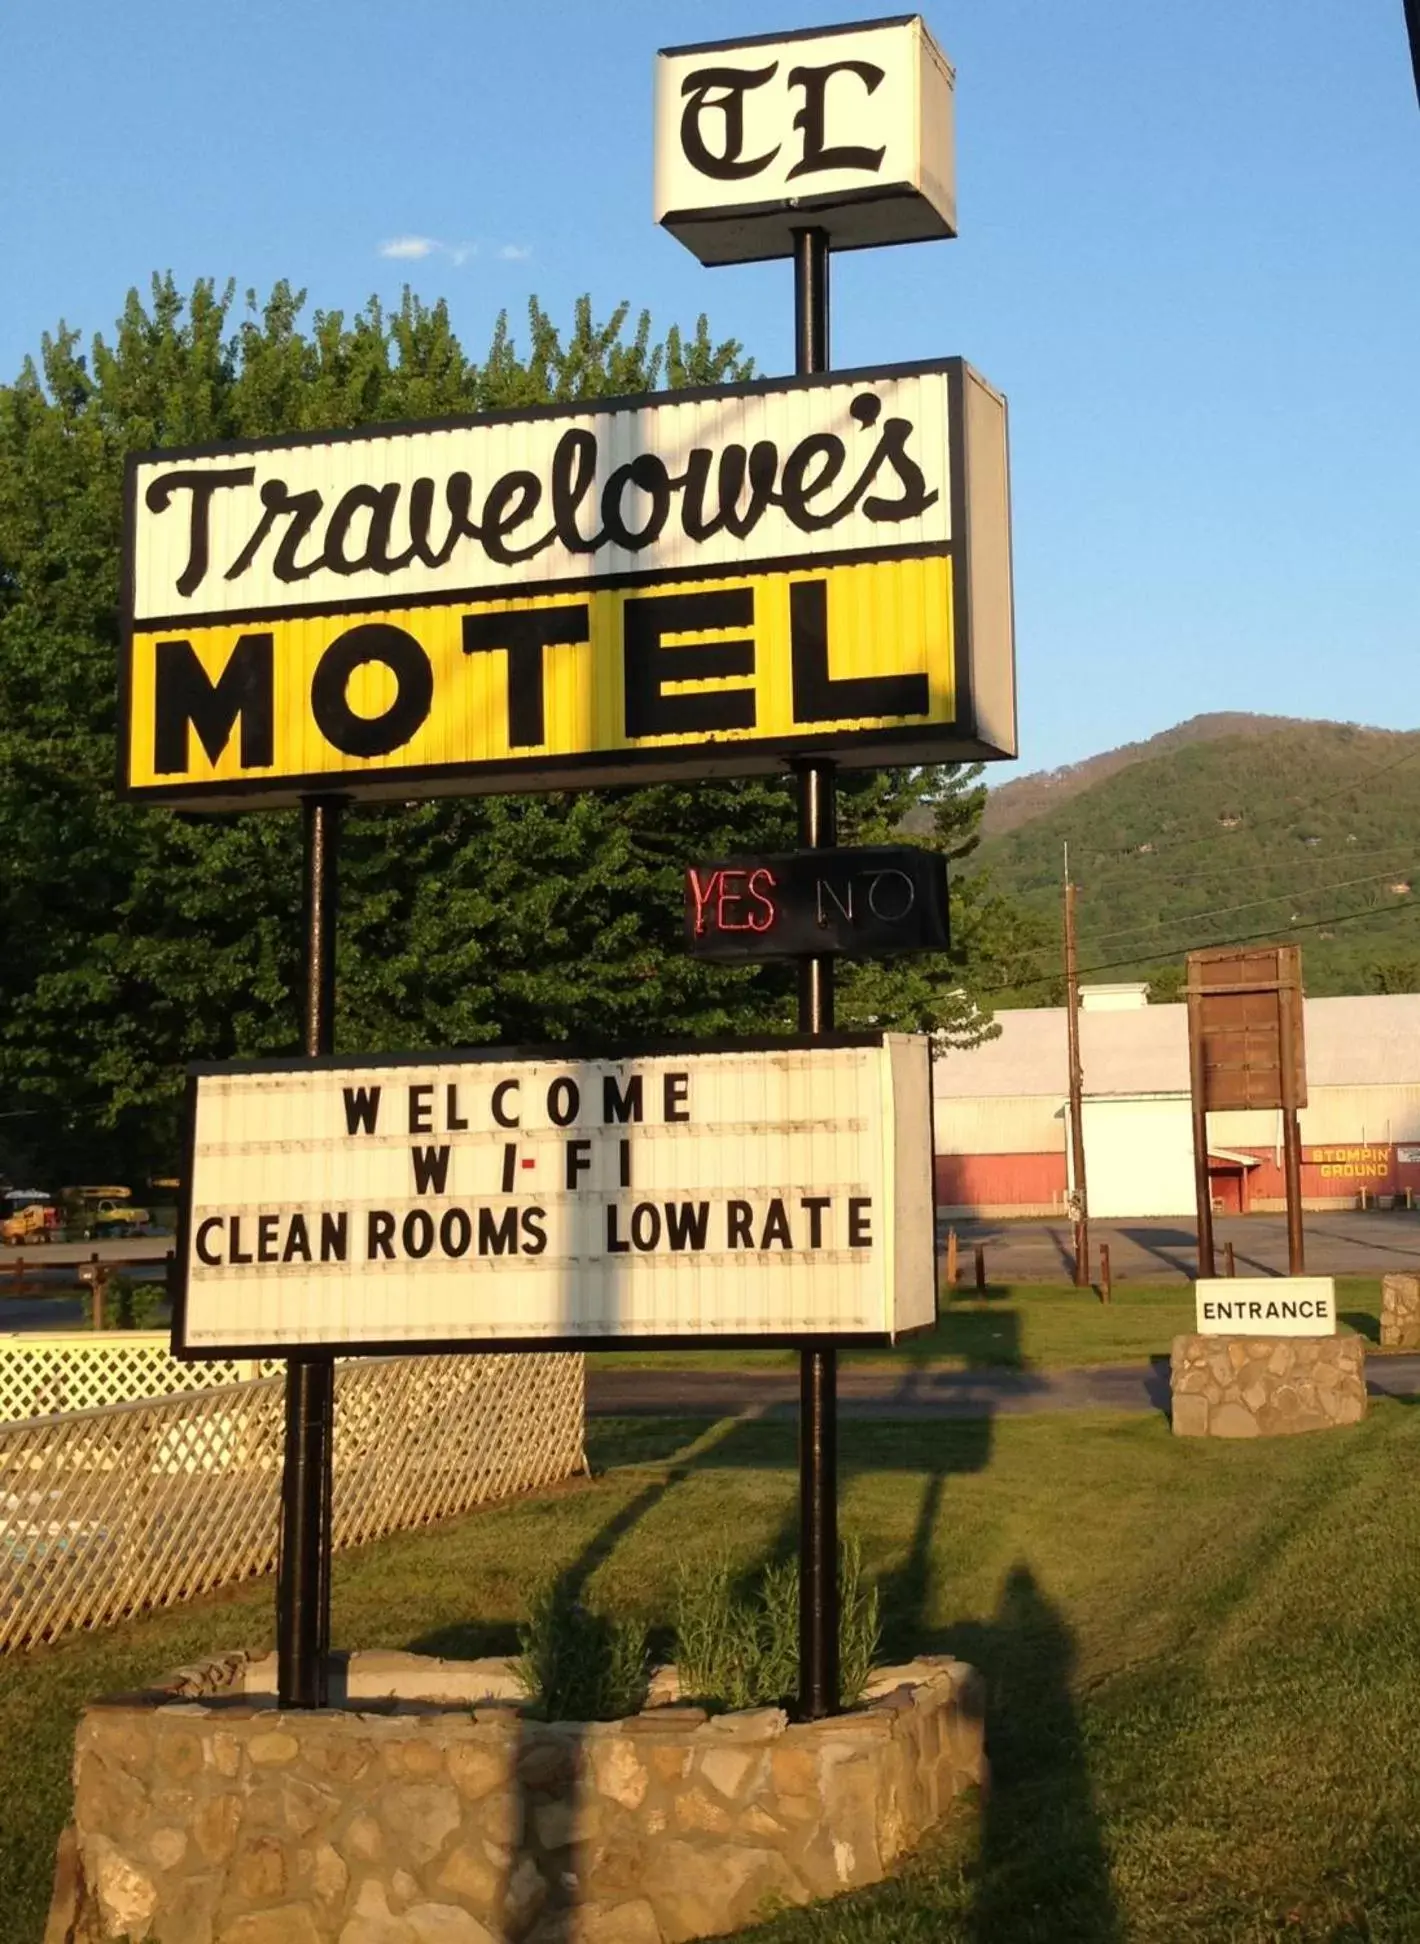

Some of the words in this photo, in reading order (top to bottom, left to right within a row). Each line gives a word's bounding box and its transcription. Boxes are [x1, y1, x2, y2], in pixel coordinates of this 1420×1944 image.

[680, 60, 886, 183] TL
[145, 392, 939, 597] Travelowe's
[154, 580, 930, 774] MOTEL
[689, 868, 776, 933] YES
[815, 868, 914, 924] NO
[342, 1072, 690, 1135] WELCOME
[1320, 1163, 1388, 1178] GROUND
[196, 1210, 348, 1266] CLEAN
[367, 1206, 547, 1259] ROOMS
[607, 1200, 710, 1253] LOW
[727, 1197, 872, 1249] RATE
[1203, 1301, 1328, 1319] ENTRANCE
